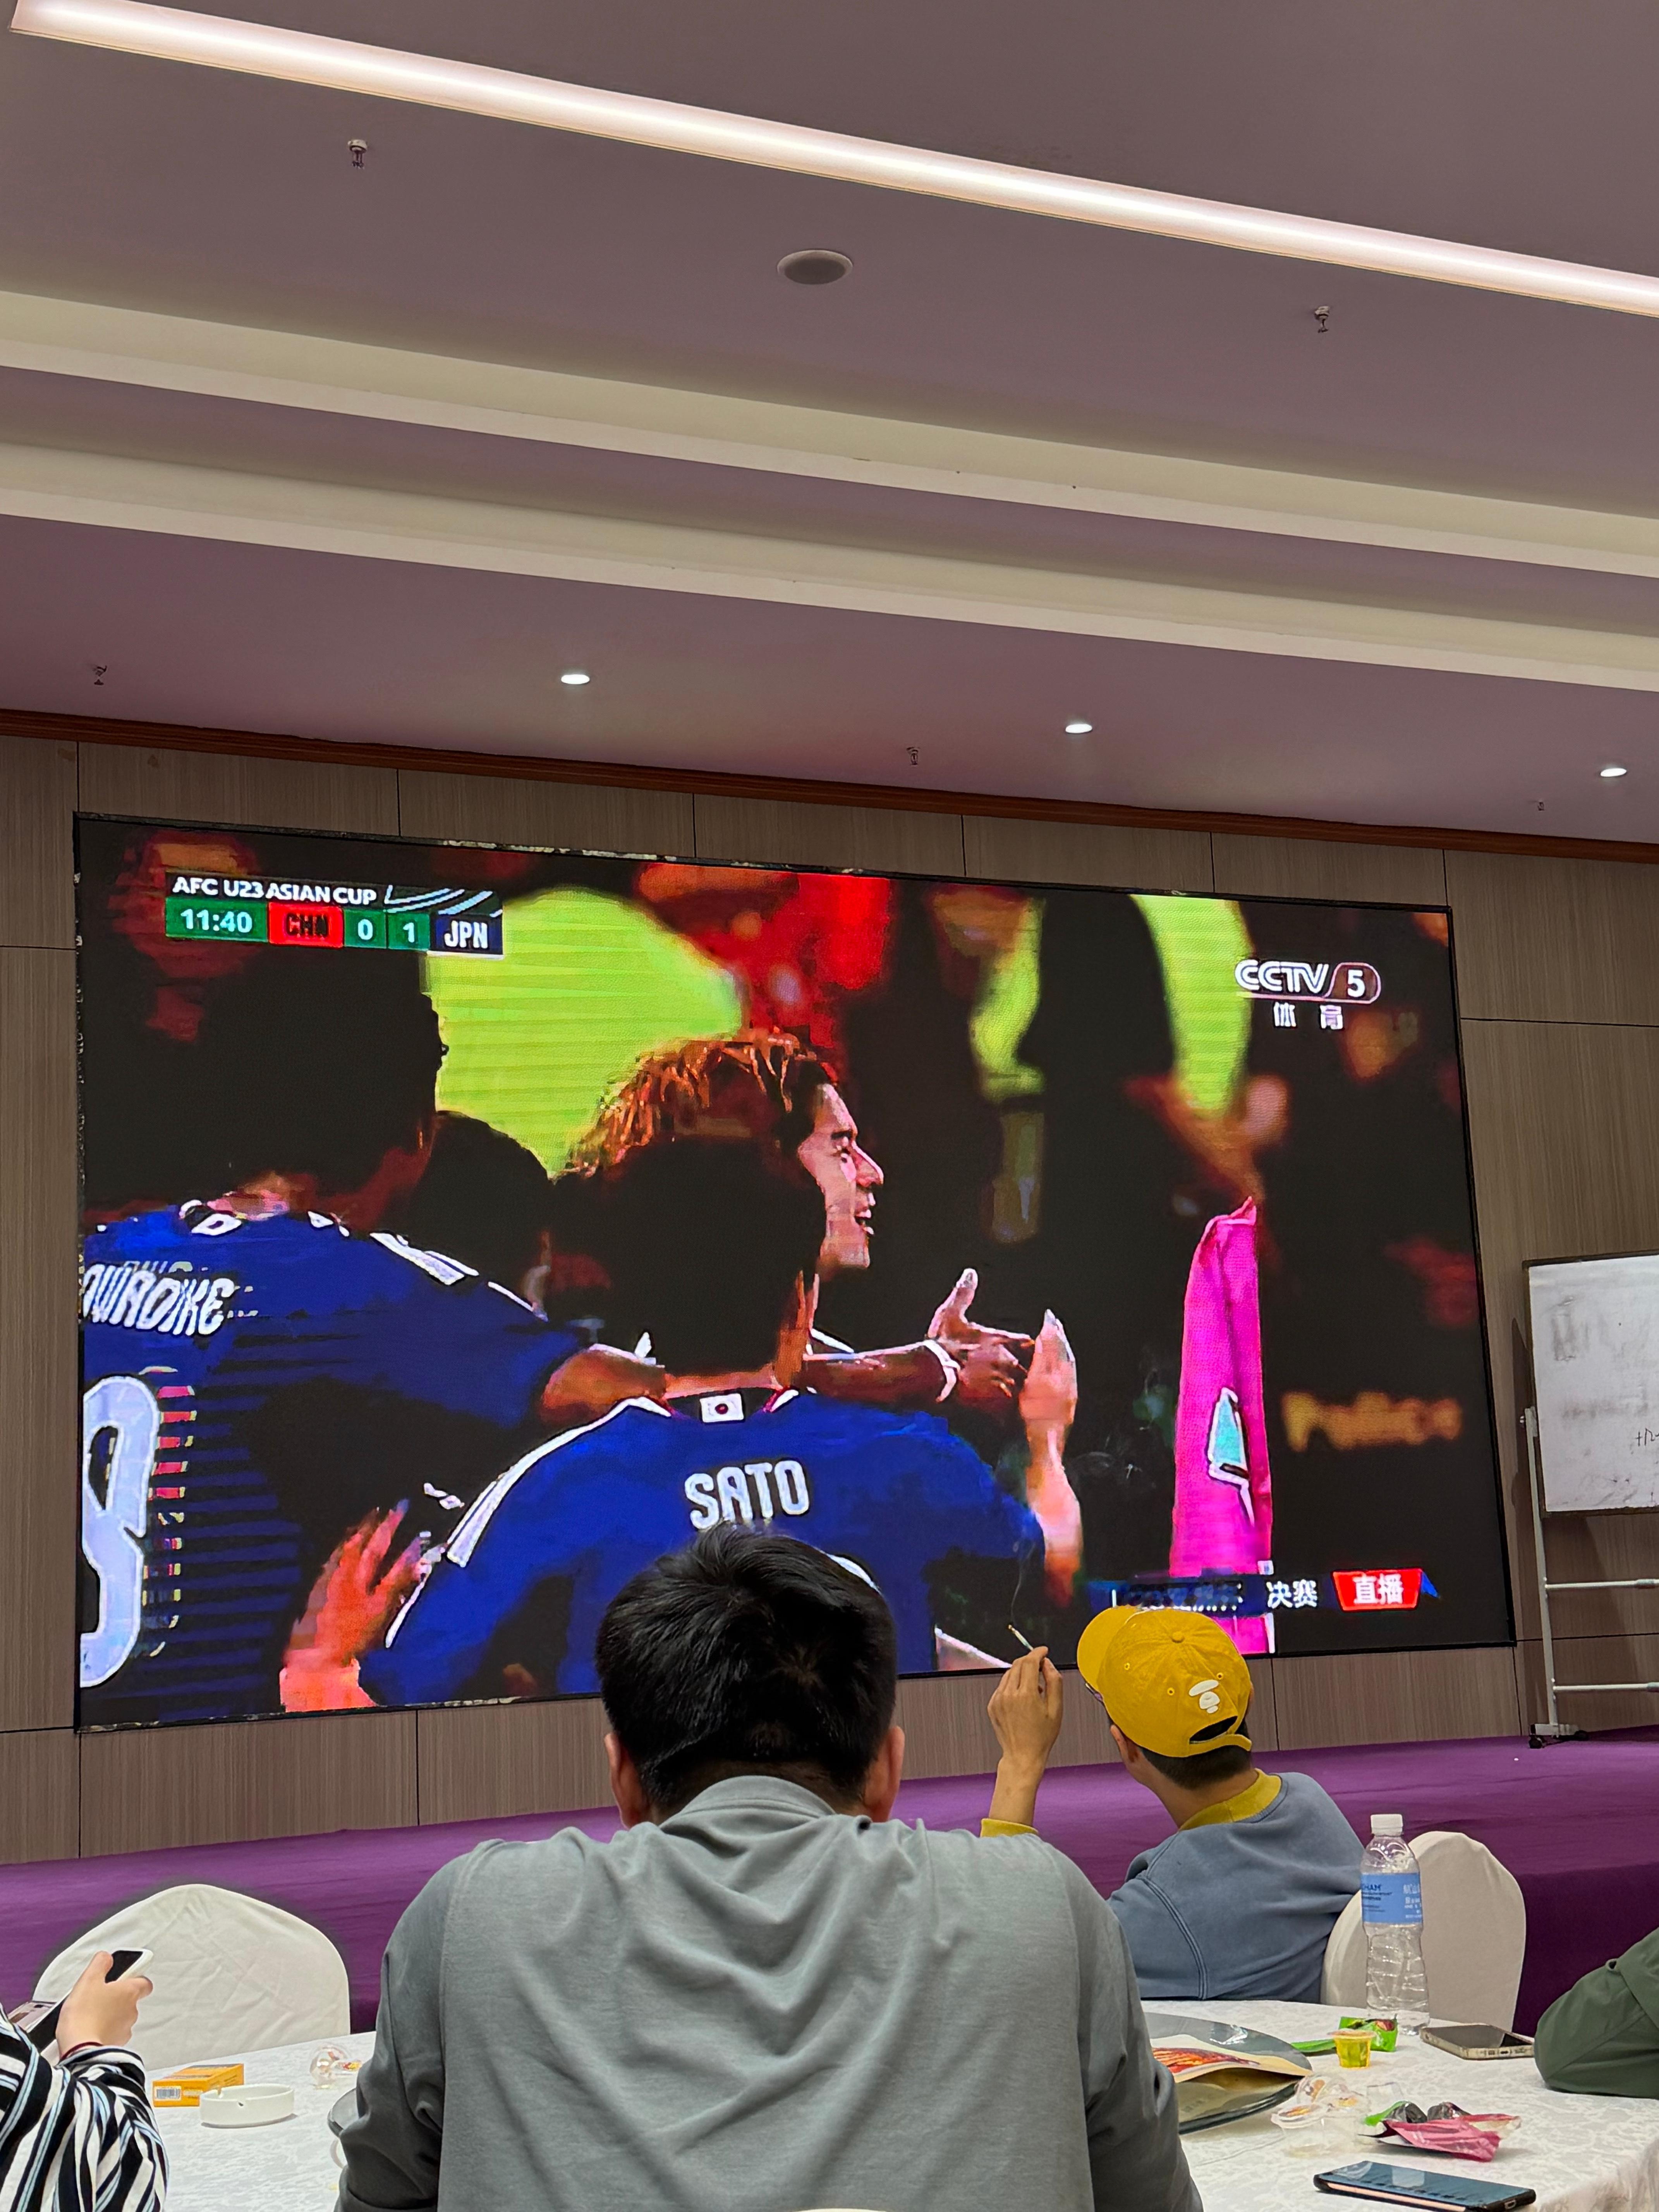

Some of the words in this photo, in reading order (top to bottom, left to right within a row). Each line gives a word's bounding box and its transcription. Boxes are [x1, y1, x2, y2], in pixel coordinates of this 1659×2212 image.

[173, 876, 219, 895] AFC
[224, 880, 265, 899] U23
[266, 883, 330, 903] ASIAN
[333, 887, 377, 905] CUP
[180, 908, 252, 933] 11:40
[357, 919, 373, 941] 0
[403, 922, 415, 943] 1
[444, 920, 488, 949] JPN
[1235, 959, 1329, 993] CCTV
[1346, 969, 1366, 998] 5
[684, 1460, 810, 1530] SATO
[1266, 1579, 1318, 1609] 决赛
[1352, 1573, 1404, 1604] 直播
